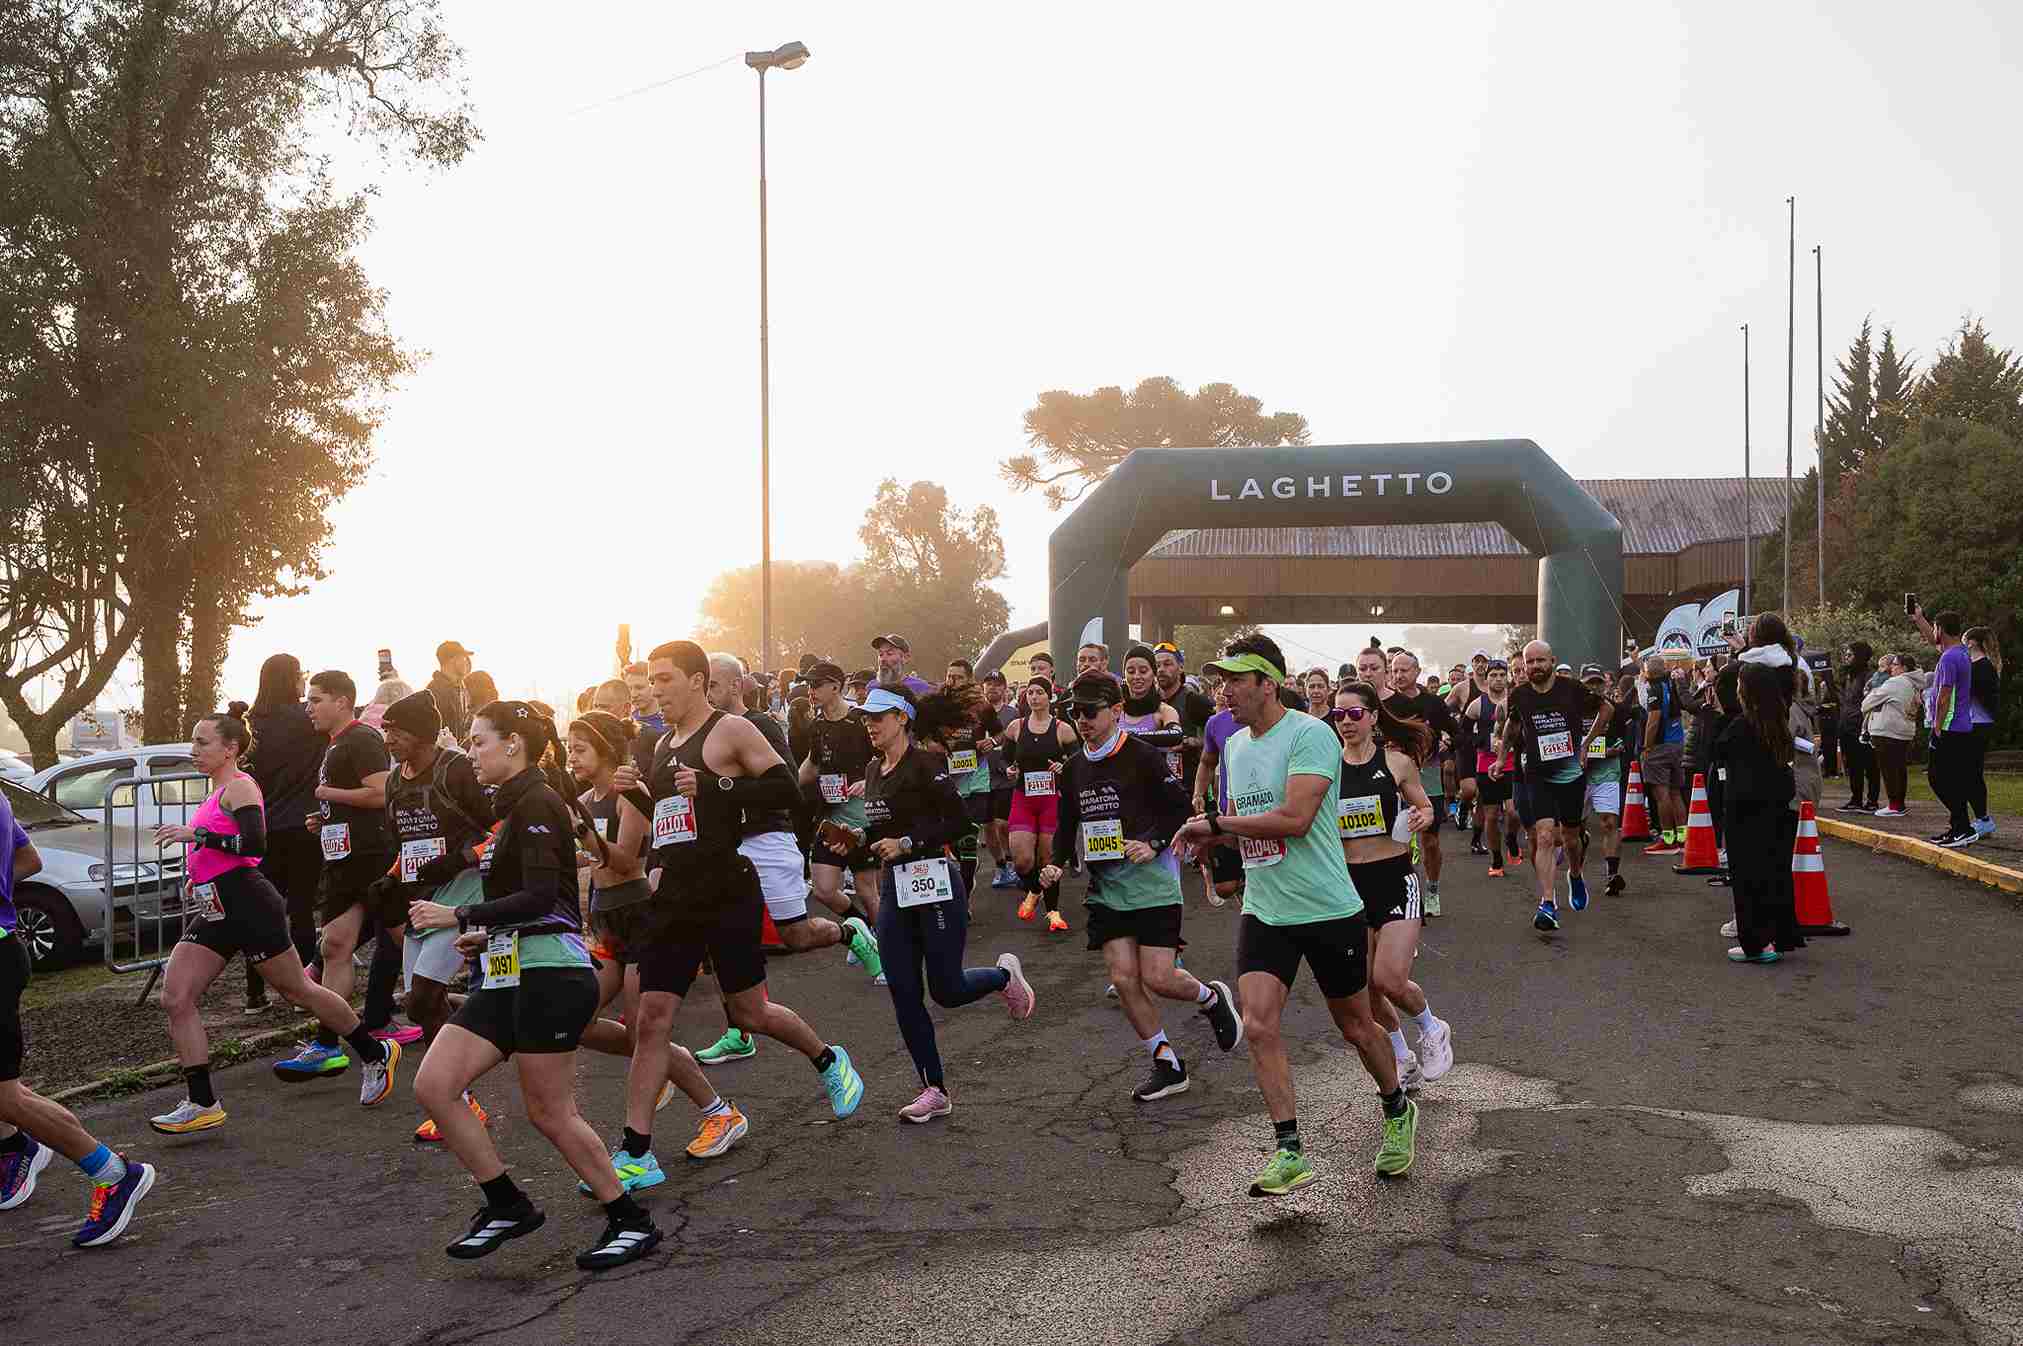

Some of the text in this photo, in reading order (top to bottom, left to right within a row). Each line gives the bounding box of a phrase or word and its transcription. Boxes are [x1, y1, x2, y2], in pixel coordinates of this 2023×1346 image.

[1209, 471, 1455, 501] LAGHETTO
[657, 813, 689, 836] 21101
[1341, 812, 1377, 830] 10102
[1088, 836, 1118, 851] 10045
[911, 878, 936, 893] 350
